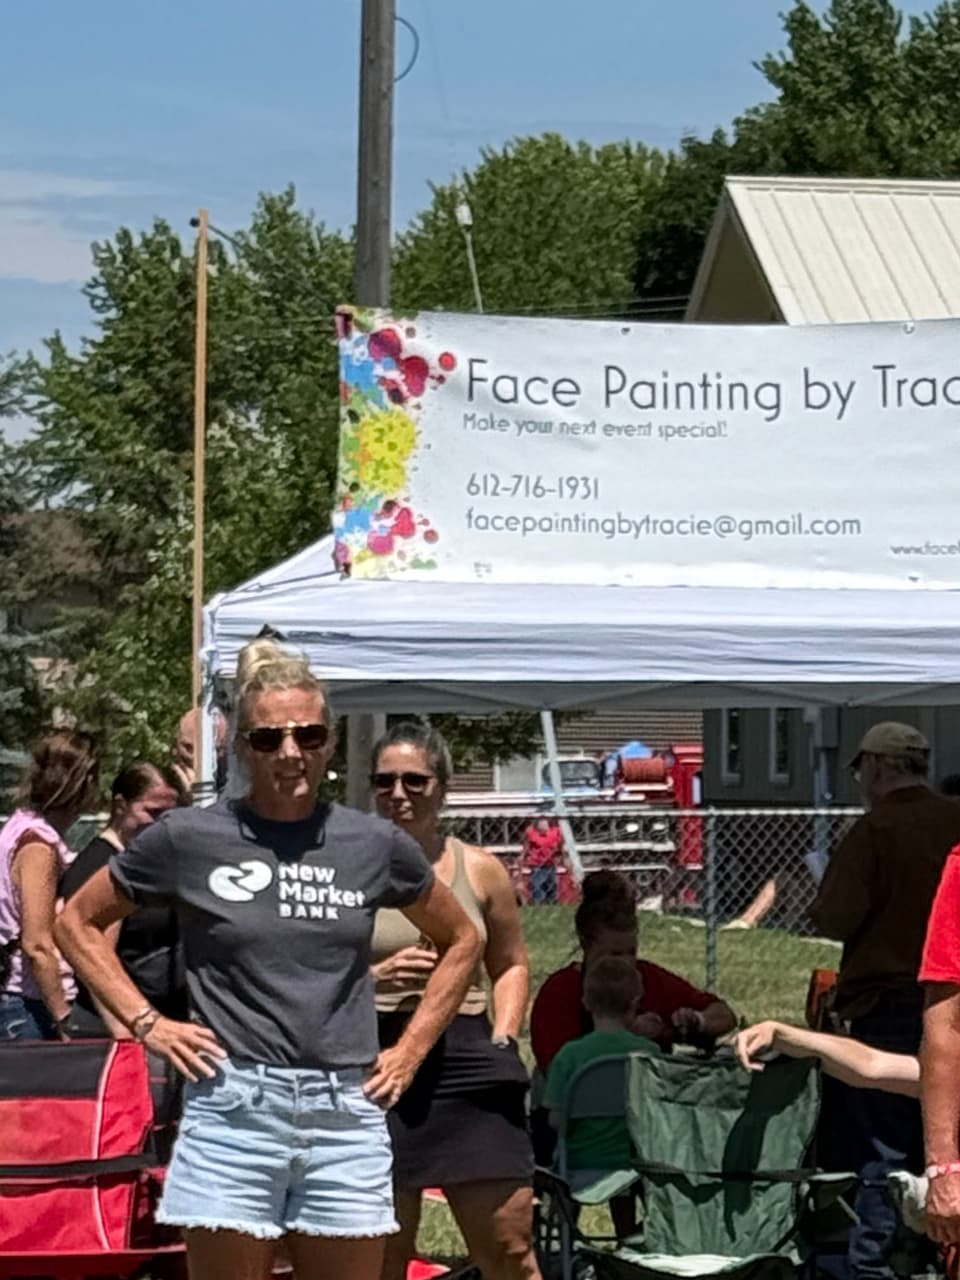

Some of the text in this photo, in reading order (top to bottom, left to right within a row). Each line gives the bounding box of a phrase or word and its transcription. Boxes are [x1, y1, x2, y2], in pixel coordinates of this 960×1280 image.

[467, 357, 582, 408] Face
[603, 364, 782, 422] Painting
[803, 366, 857, 421] by
[463, 412, 729, 442] Make your next event special!
[466, 472, 600, 500] 612-716-1931
[465, 507, 862, 540] facepaintingbytracie@gmail.com
[278, 863, 336, 883] New
[278, 882, 365, 907] Market
[278, 903, 339, 919] BANK
